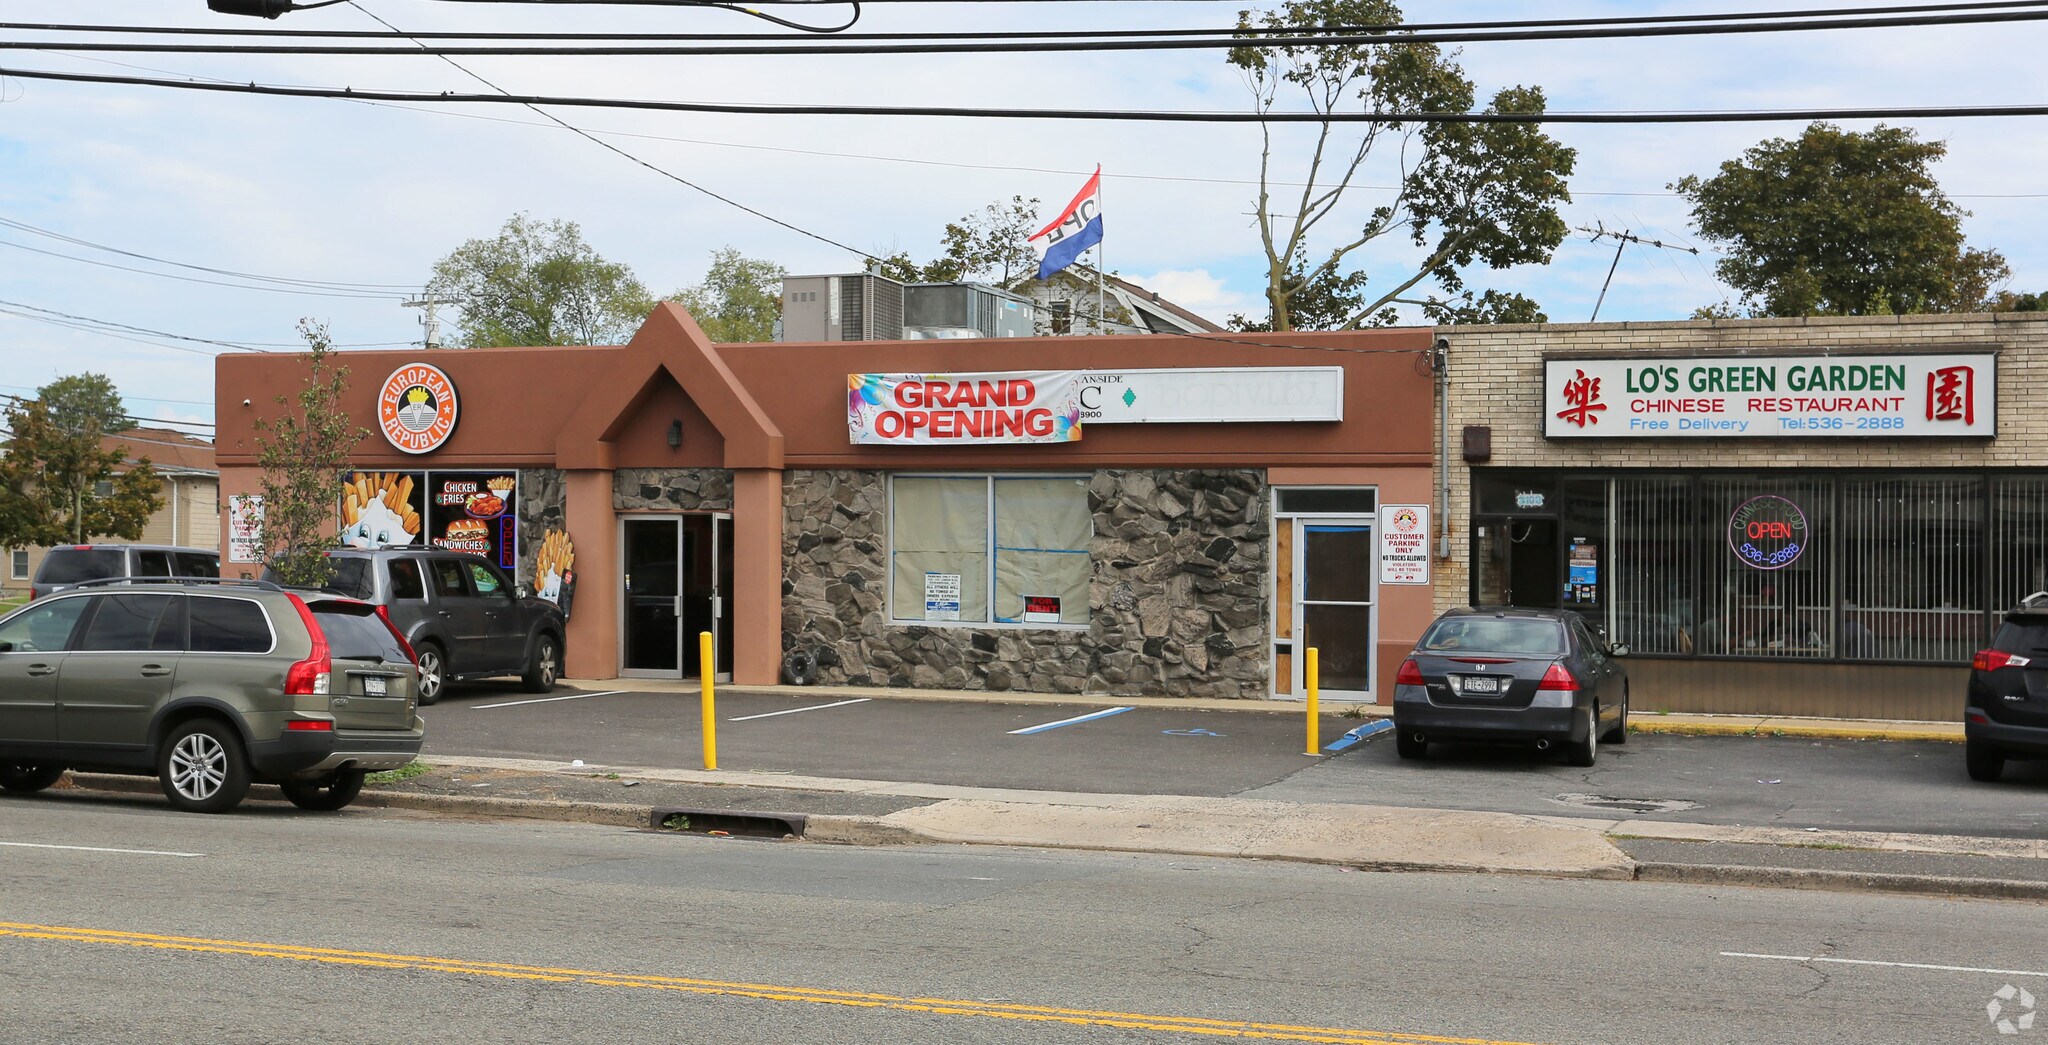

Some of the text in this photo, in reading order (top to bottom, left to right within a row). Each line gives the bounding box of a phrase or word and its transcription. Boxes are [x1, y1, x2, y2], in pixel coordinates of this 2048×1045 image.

[385, 369, 451, 404] EUROPEAN
[1081, 375, 1123, 384] ANSIDE
[1626, 364, 1906, 394] LO'S GREEN GARDEN
[894, 379, 1036, 408] GRAND
[1630, 397, 1905, 413] CHINESE RESTAURANT
[385, 417, 450, 449] REPUBLIC
[874, 408, 1054, 438] OPENING
[1629, 417, 1670, 431] Free
[1678, 417, 1749, 433] Delivery
[444, 481, 477, 493] CHICKEN
[443, 494, 465, 505] FRIES
[1733, 499, 1805, 530] CHINESE FOOD
[1747, 521, 1792, 539] OPEN
[433, 538, 483, 550] SANDWICHES
[502, 517, 514, 566] OPEN
[1740, 542, 1799, 564] 536-2888
